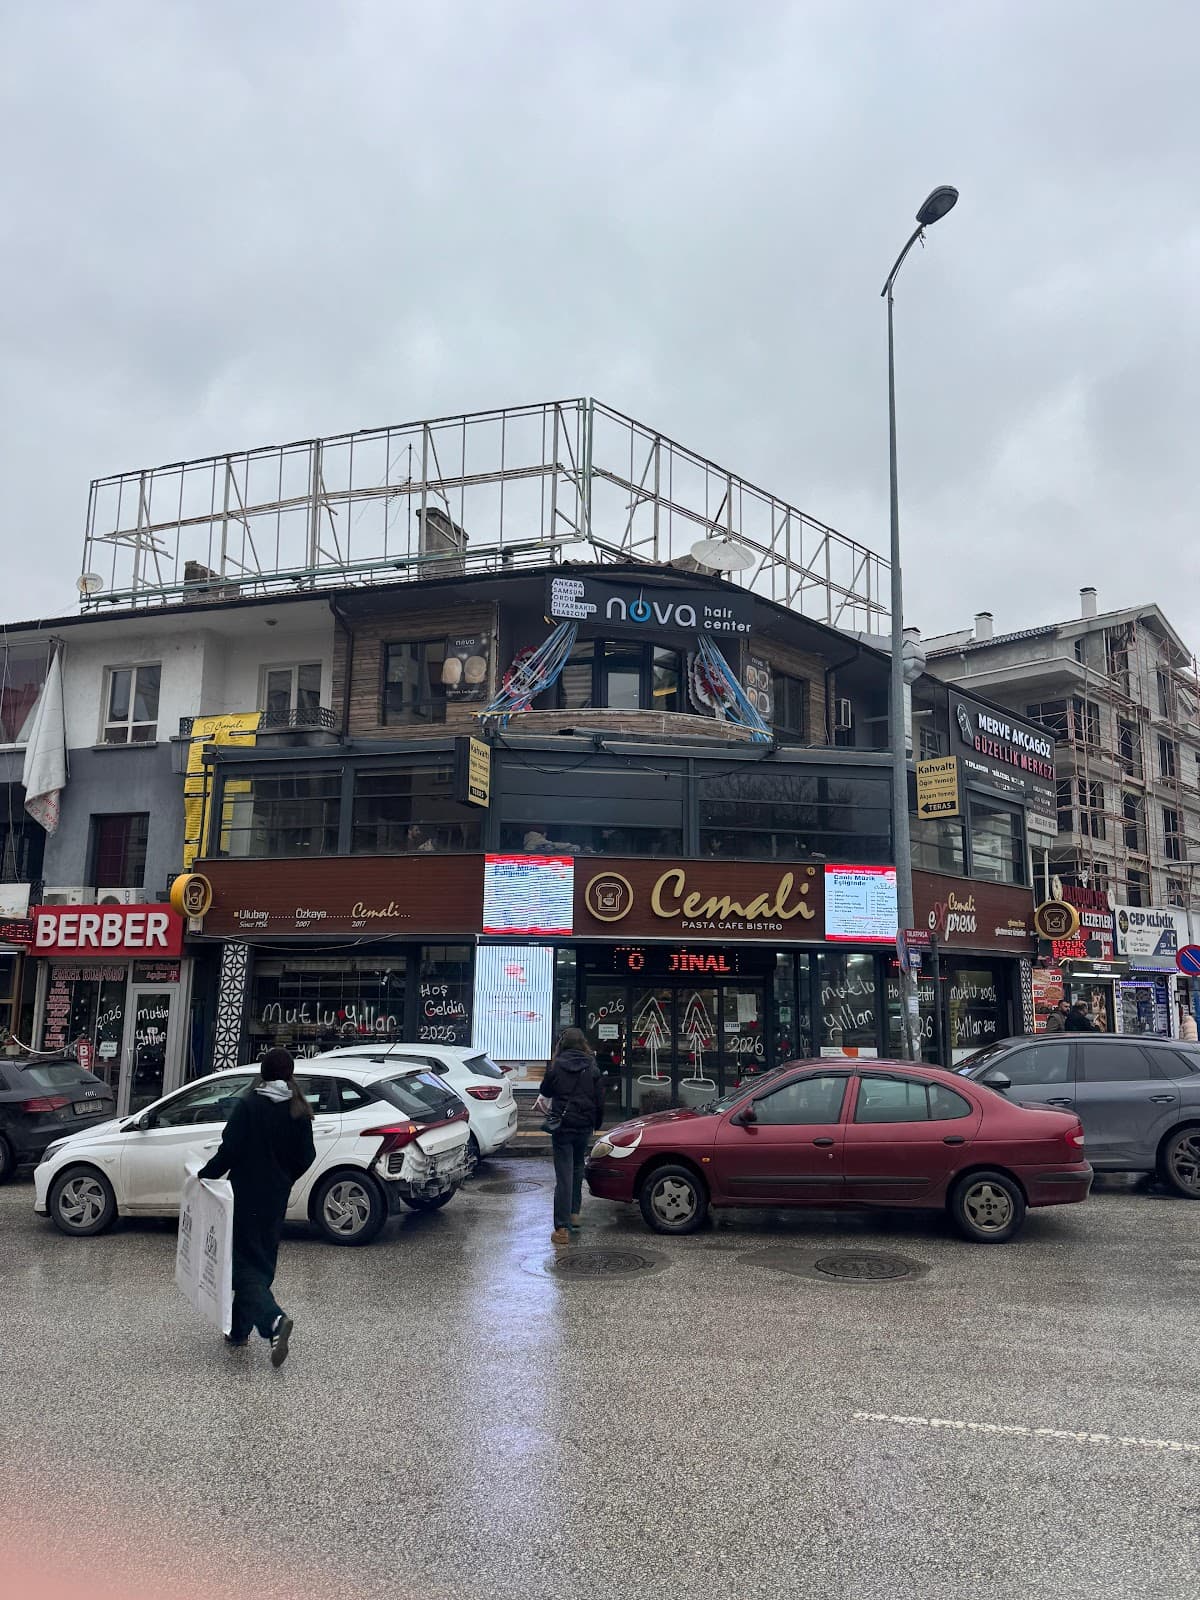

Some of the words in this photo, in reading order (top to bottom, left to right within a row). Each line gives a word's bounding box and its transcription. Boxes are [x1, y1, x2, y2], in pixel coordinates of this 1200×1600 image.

[553, 579, 583, 588] ANKARA
[553, 587, 583, 596] SAMSUN
[553, 594, 574, 602] ORDU
[552, 608, 586, 617] TRABZON
[703, 605, 733, 619] hair
[703, 619, 752, 634] center
[978, 712, 1010, 742] MERVE
[1012, 731, 1051, 759] AKÇAGÖZ
[974, 735, 1018, 767] GÜZELLİK
[918, 762, 955, 774] Kahvaltı
[928, 802, 952, 811] TERAS
[651, 868, 815, 919] Cemali
[239, 909, 270, 921] Ulubay
[295, 907, 327, 920] Özkaya
[351, 901, 400, 918] Cemali
[681, 921, 715, 930] PASTA
[717, 922, 744, 930] CAFE
[746, 922, 783, 931] BISTRO
[1129, 912, 1146, 926] CEP
[1146, 912, 1174, 929] KLİNİK
[35, 912, 170, 948] BERBER
[1053, 947, 1088, 957] EKMEK
[424, 999, 465, 1017] Geldin
[588, 998, 625, 1030] 2026
[728, 1035, 764, 1056] 2026
